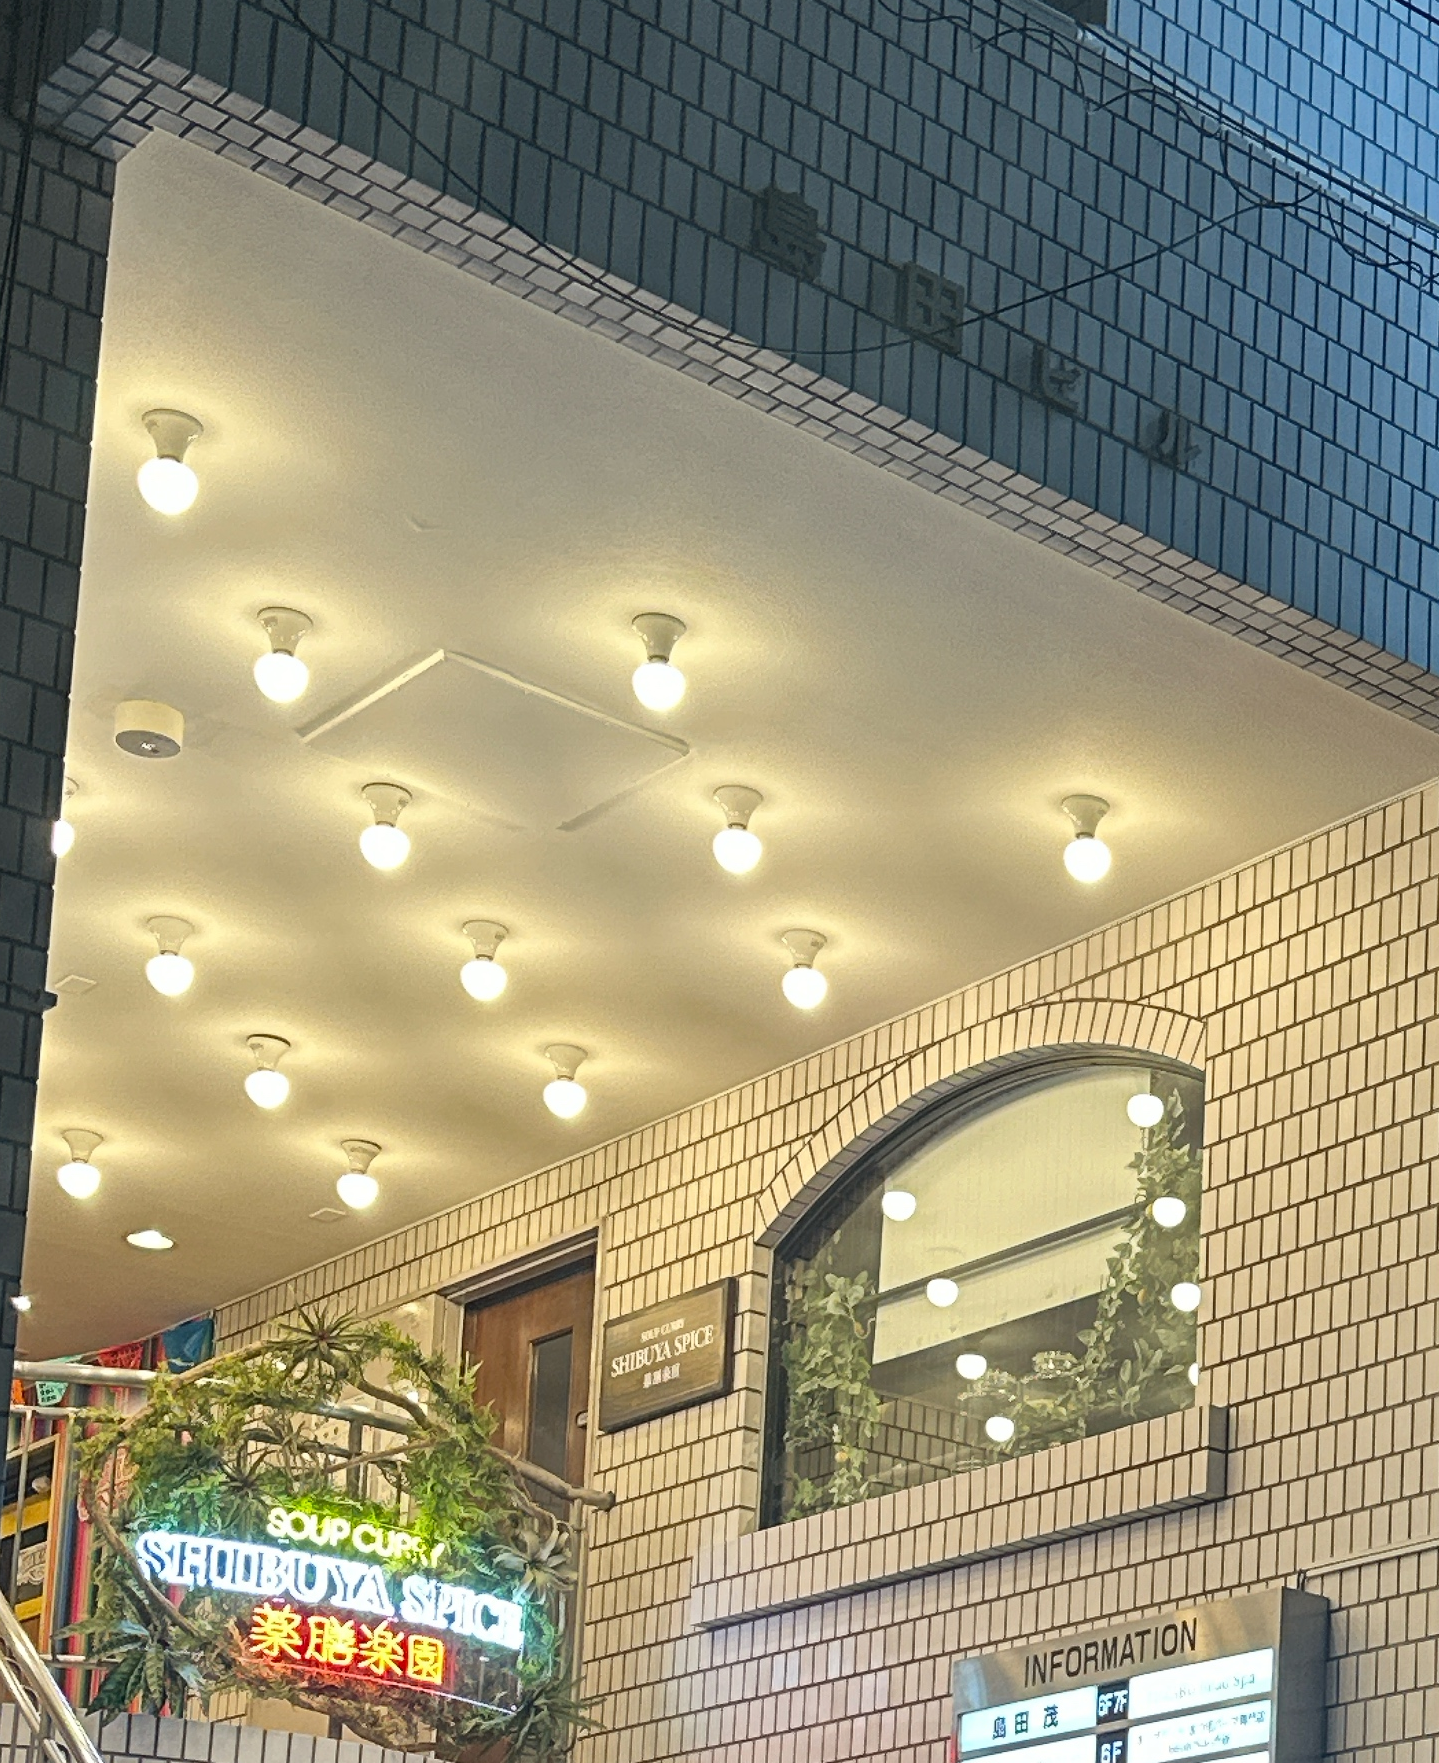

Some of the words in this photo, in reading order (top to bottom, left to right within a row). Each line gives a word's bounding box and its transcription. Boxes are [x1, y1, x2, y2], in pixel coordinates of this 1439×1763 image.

[611, 1340, 672, 1378] SHIBUYA
[674, 1324, 714, 1356] SPICE
[267, 1507, 351, 1547] SOUP
[135, 1530, 396, 1617] SHIBUYA
[400, 1575, 525, 1651] SPICE
[249, 1602, 445, 1685] 薬膳楽園
[1024, 1617, 1198, 1689] INFORMATION
